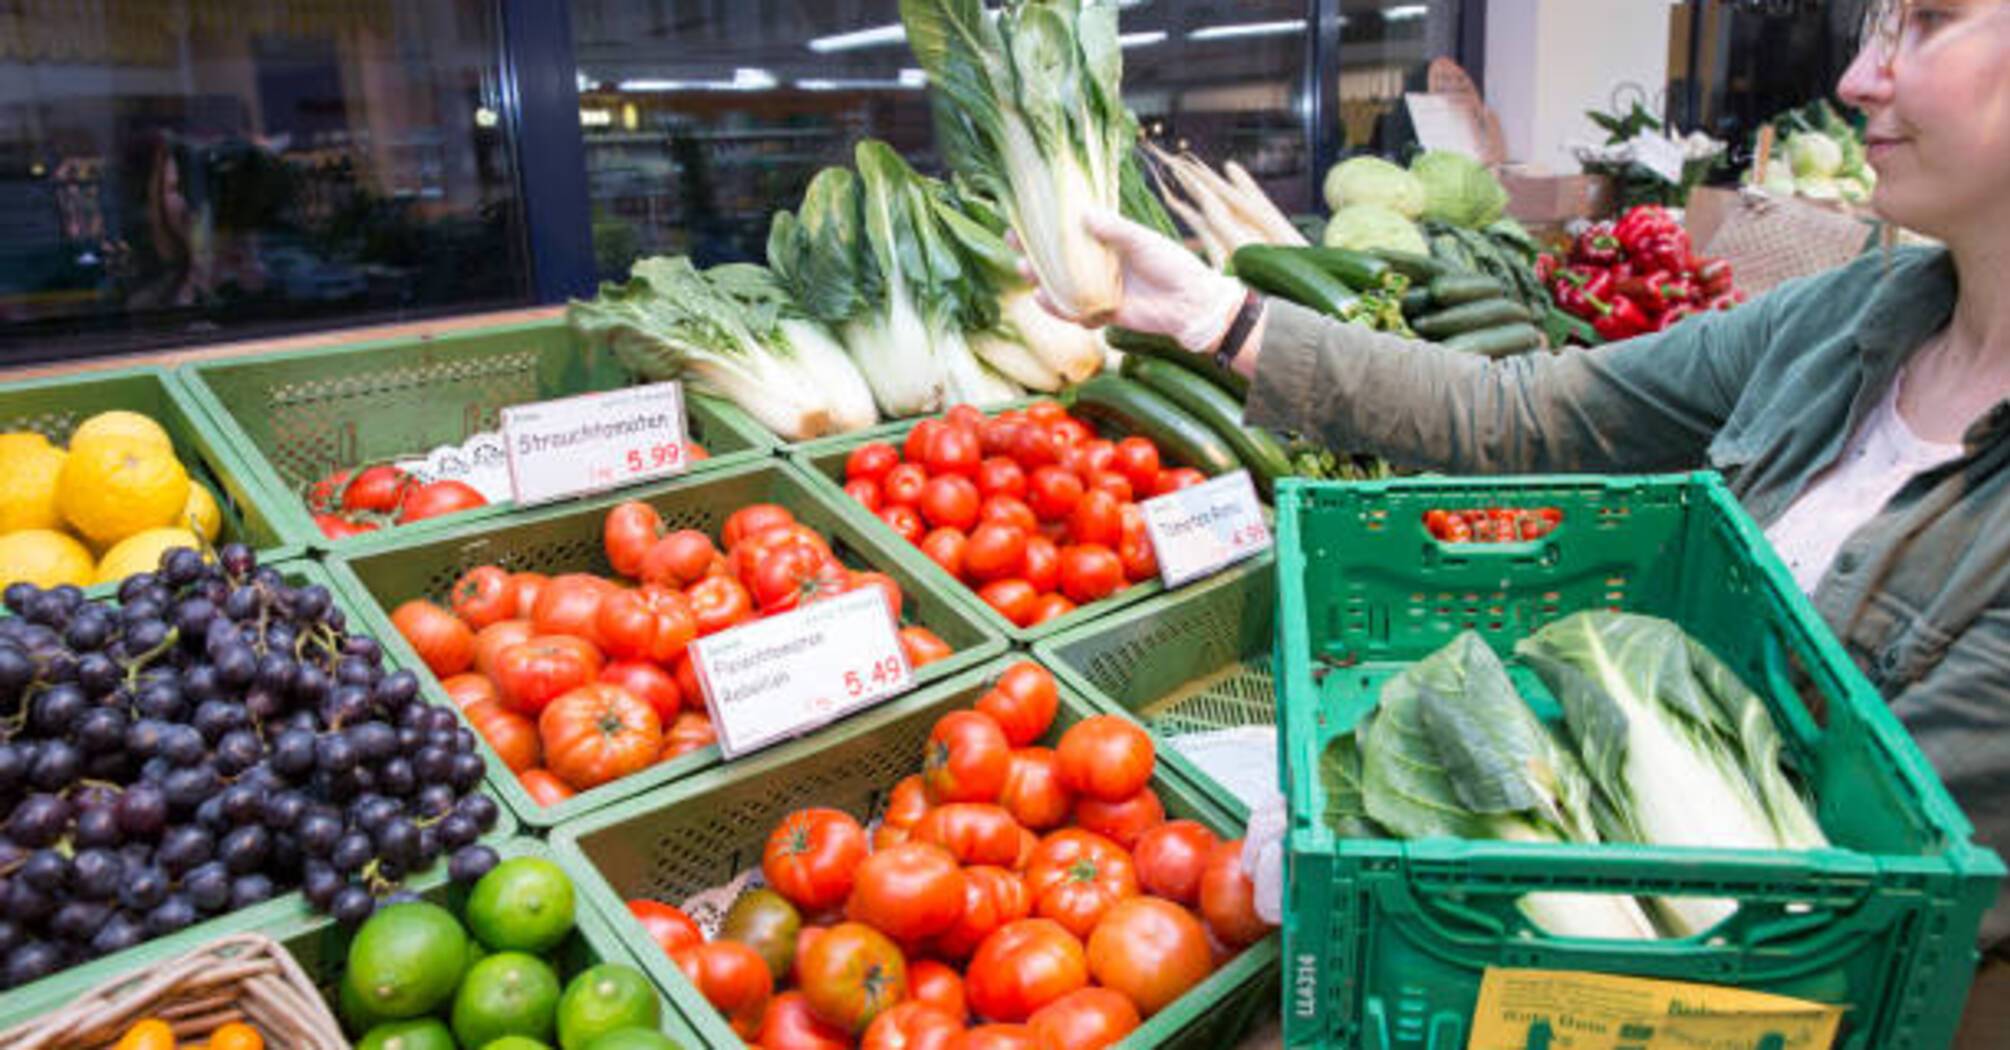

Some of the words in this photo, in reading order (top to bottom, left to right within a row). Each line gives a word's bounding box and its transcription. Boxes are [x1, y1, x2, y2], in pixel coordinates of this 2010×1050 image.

[519, 413, 669, 455] Strauchtomaten
[627, 443, 679, 472] 5.99
[843, 655, 901, 697] 5.49
